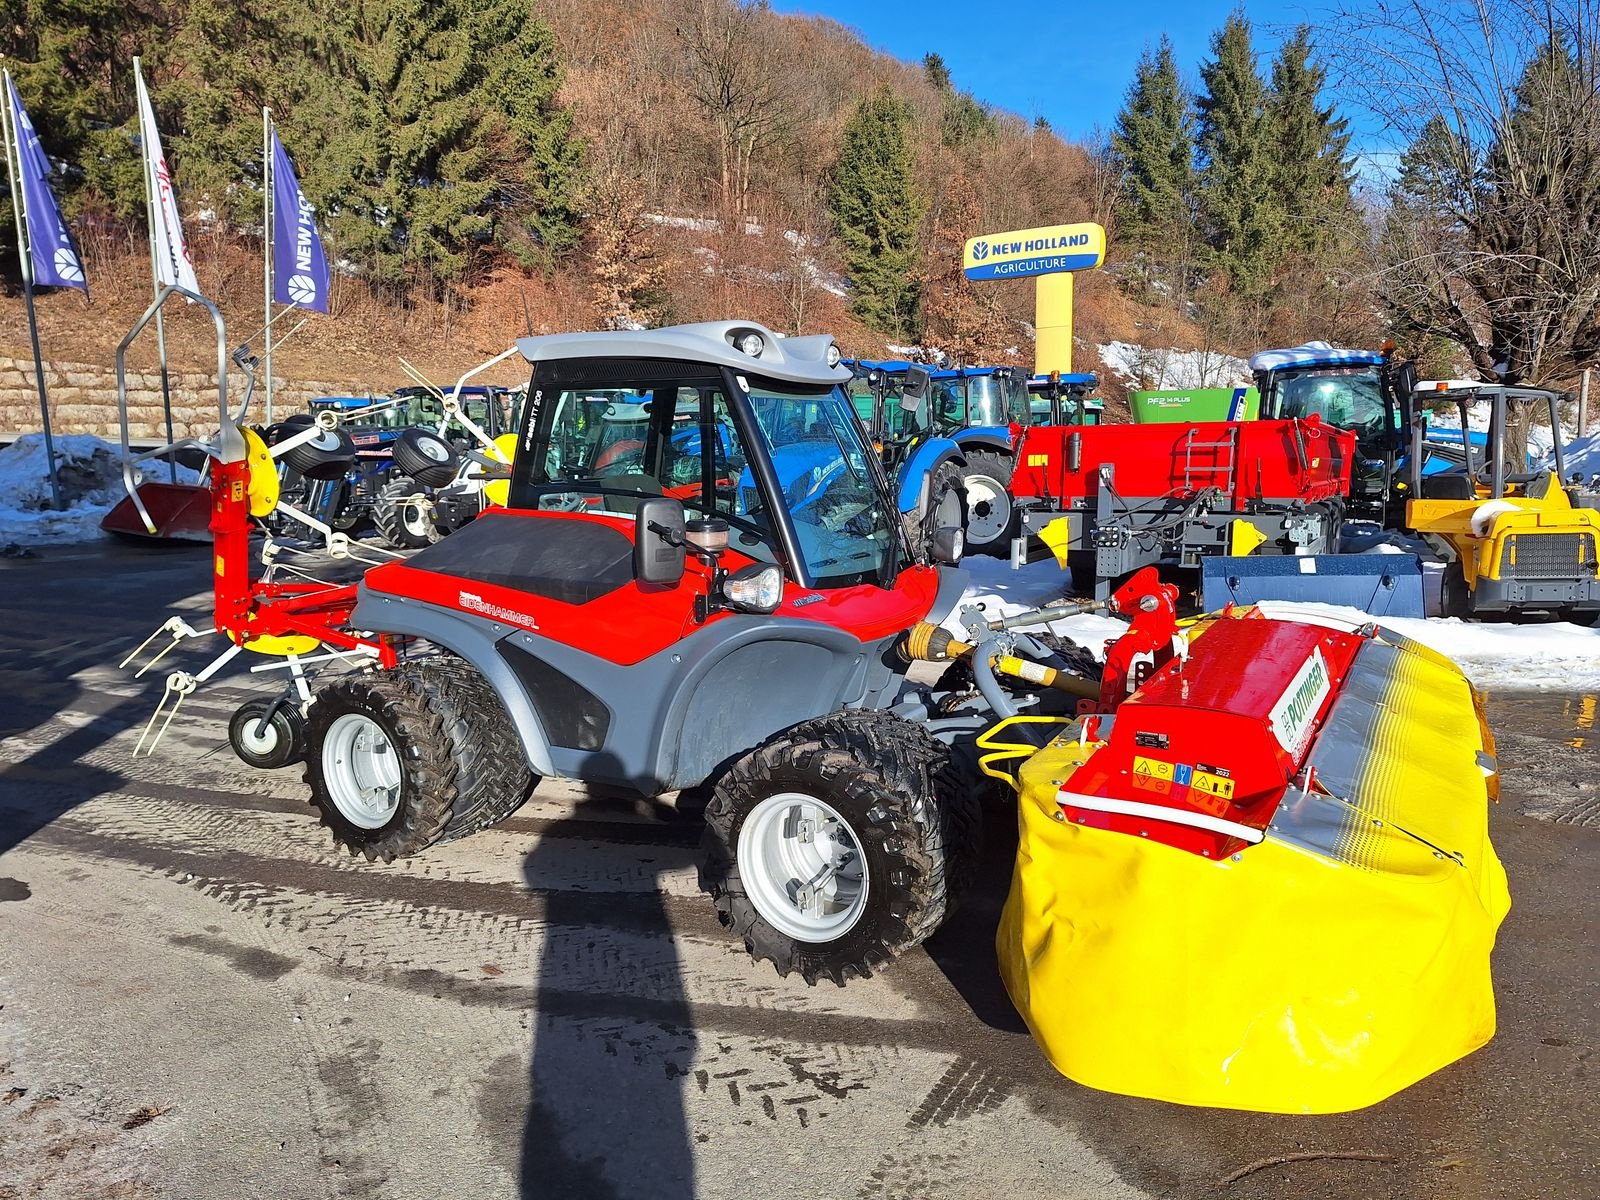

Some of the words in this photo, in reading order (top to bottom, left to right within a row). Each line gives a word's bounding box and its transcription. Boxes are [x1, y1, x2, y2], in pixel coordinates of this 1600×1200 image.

[296, 227, 312, 271] NEW
[992, 241, 1022, 255] NEW
[1024, 234, 1089, 252] HOLLAND
[993, 257, 1067, 275] AGRICULTURE
[458, 595, 535, 628] EIDENHAMMER
